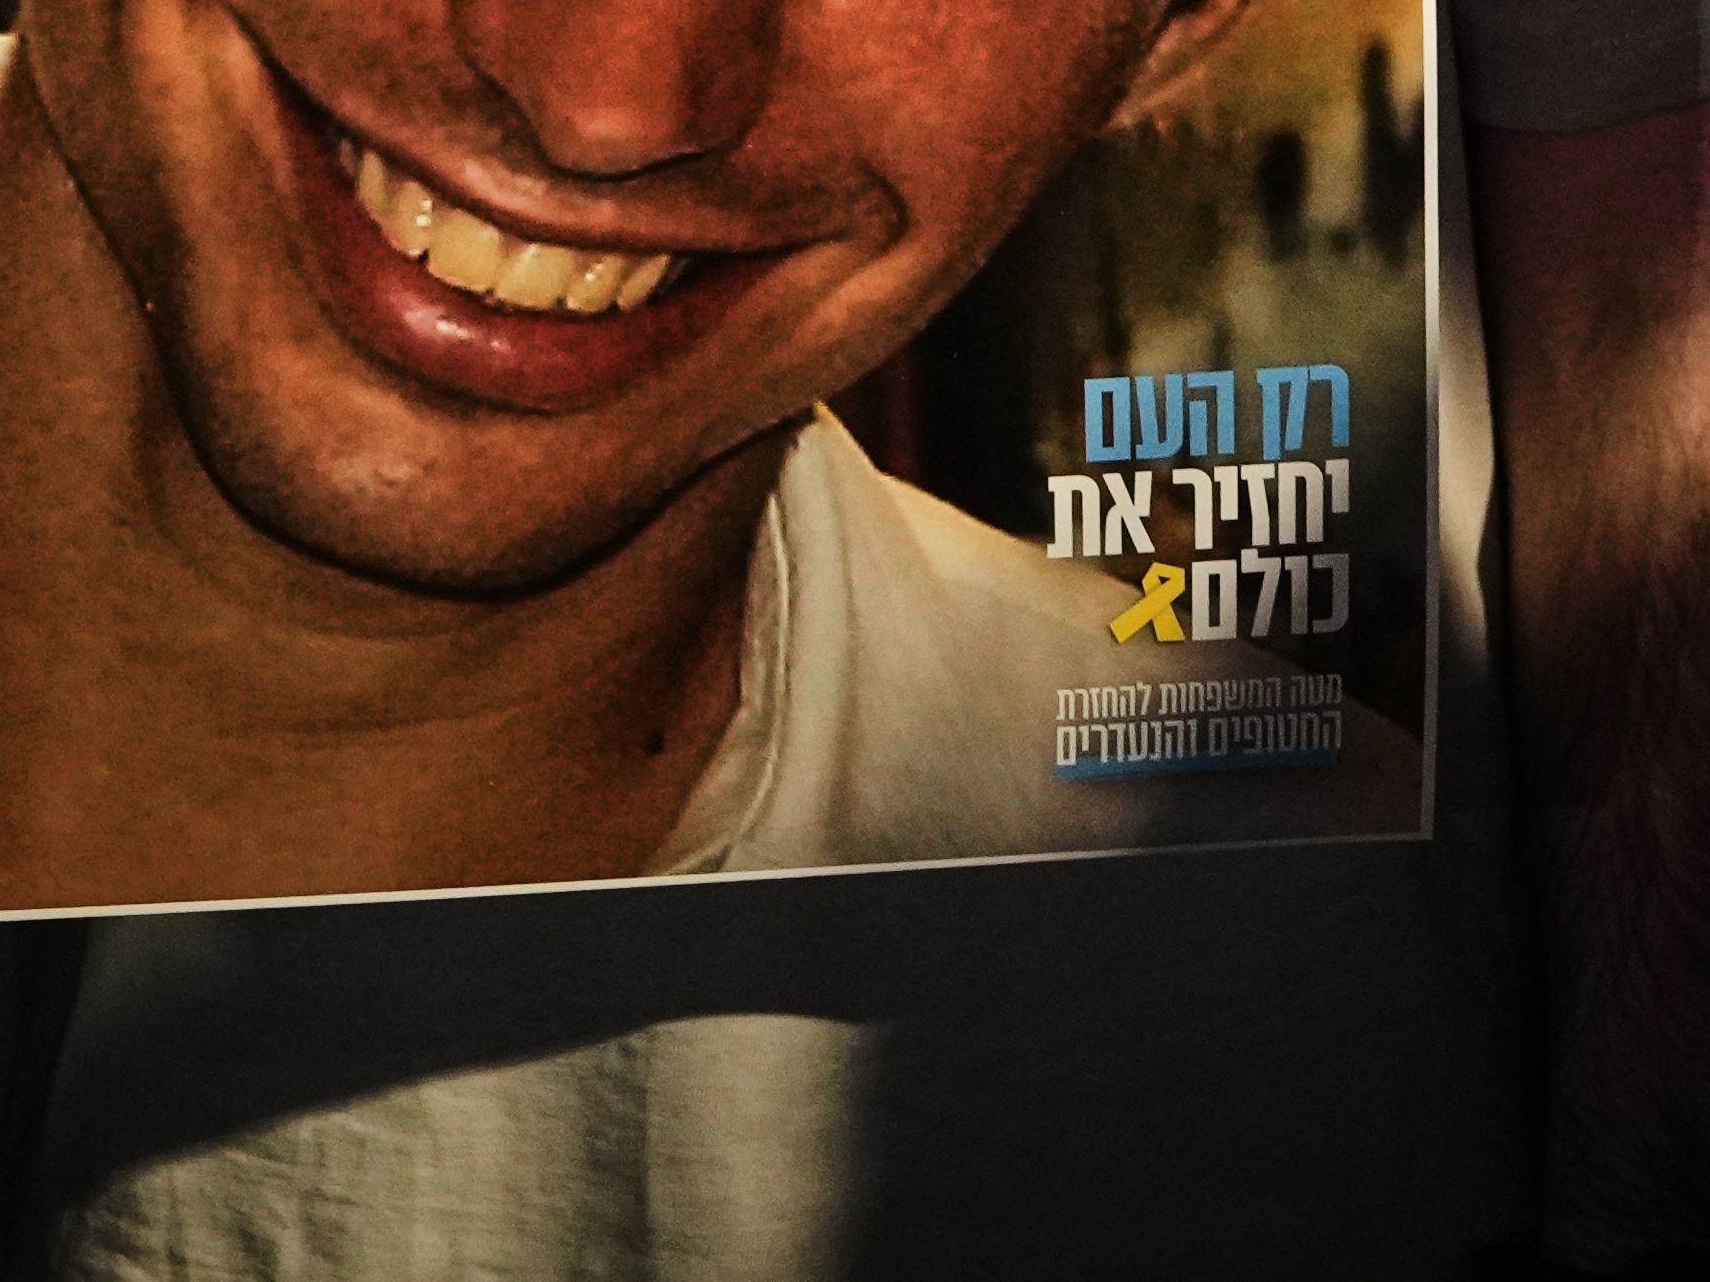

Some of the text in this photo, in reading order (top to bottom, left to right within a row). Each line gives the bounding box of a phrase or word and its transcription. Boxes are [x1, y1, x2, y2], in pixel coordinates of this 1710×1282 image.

[1083, 363, 1351, 463] רק העם
[1046, 458, 1351, 559] יחזיר את
[1191, 548, 1350, 642] כולם
[1055, 672, 1342, 721] מטה המשפחות להחזרת
[1055, 710, 1342, 767] החטופים והנעדרים
